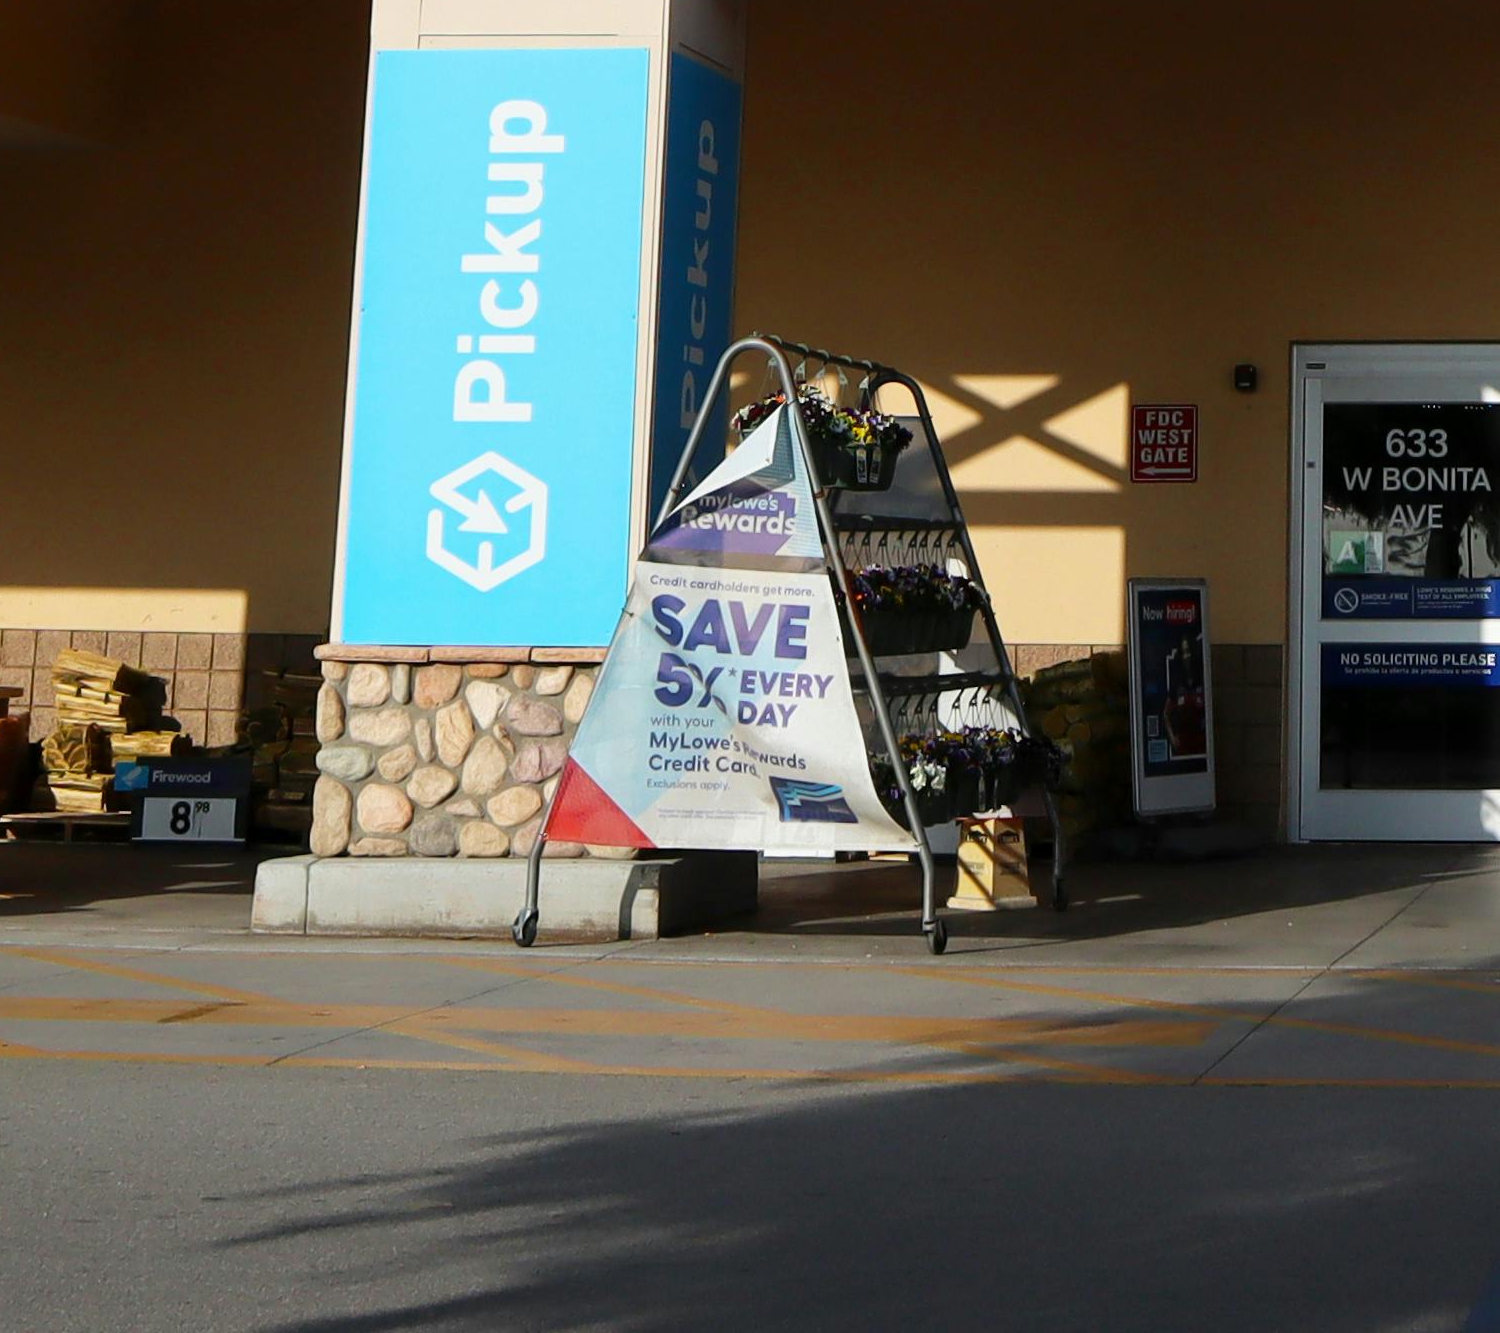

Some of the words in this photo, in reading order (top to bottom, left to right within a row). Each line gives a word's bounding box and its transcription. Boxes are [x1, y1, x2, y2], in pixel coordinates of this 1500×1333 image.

[452, 99, 566, 423] Pickup
[680, 119, 718, 430] Pickup
[1145, 411, 1184, 427] FDC
[1138, 429, 1192, 445] WEST
[1385, 429, 1448, 458] 633
[1140, 447, 1188, 463] GATE
[1342, 467, 1372, 491] W
[1382, 467, 1492, 492] BONITA
[679, 506, 797, 535] Rewards
[1389, 504, 1444, 529] AVE
[649, 574, 688, 589] Credit
[689, 578, 760, 594] cardholders
[762, 584, 782, 598] get
[784, 586, 816, 598] more.
[1142, 606, 1163, 621] Now
[1166, 604, 1196, 623] hiring!
[651, 593, 811, 660] SAVE
[1340, 653, 1360, 665] NO
[1363, 653, 1439, 666] SOLICITING
[1442, 653, 1496, 666] PLEASE
[739, 669, 835, 700] EVERY
[650, 714, 681, 727] with
[684, 717, 715, 730] your
[737, 700, 798, 728] DAY
[649, 731, 741, 753] MyLowe's
[649, 754, 710, 772] Credit
[152, 769, 211, 783] Firewood
[646, 778, 697, 790] Exclusions
[700, 779, 731, 791] apply.
[170, 800, 192, 835] 8
